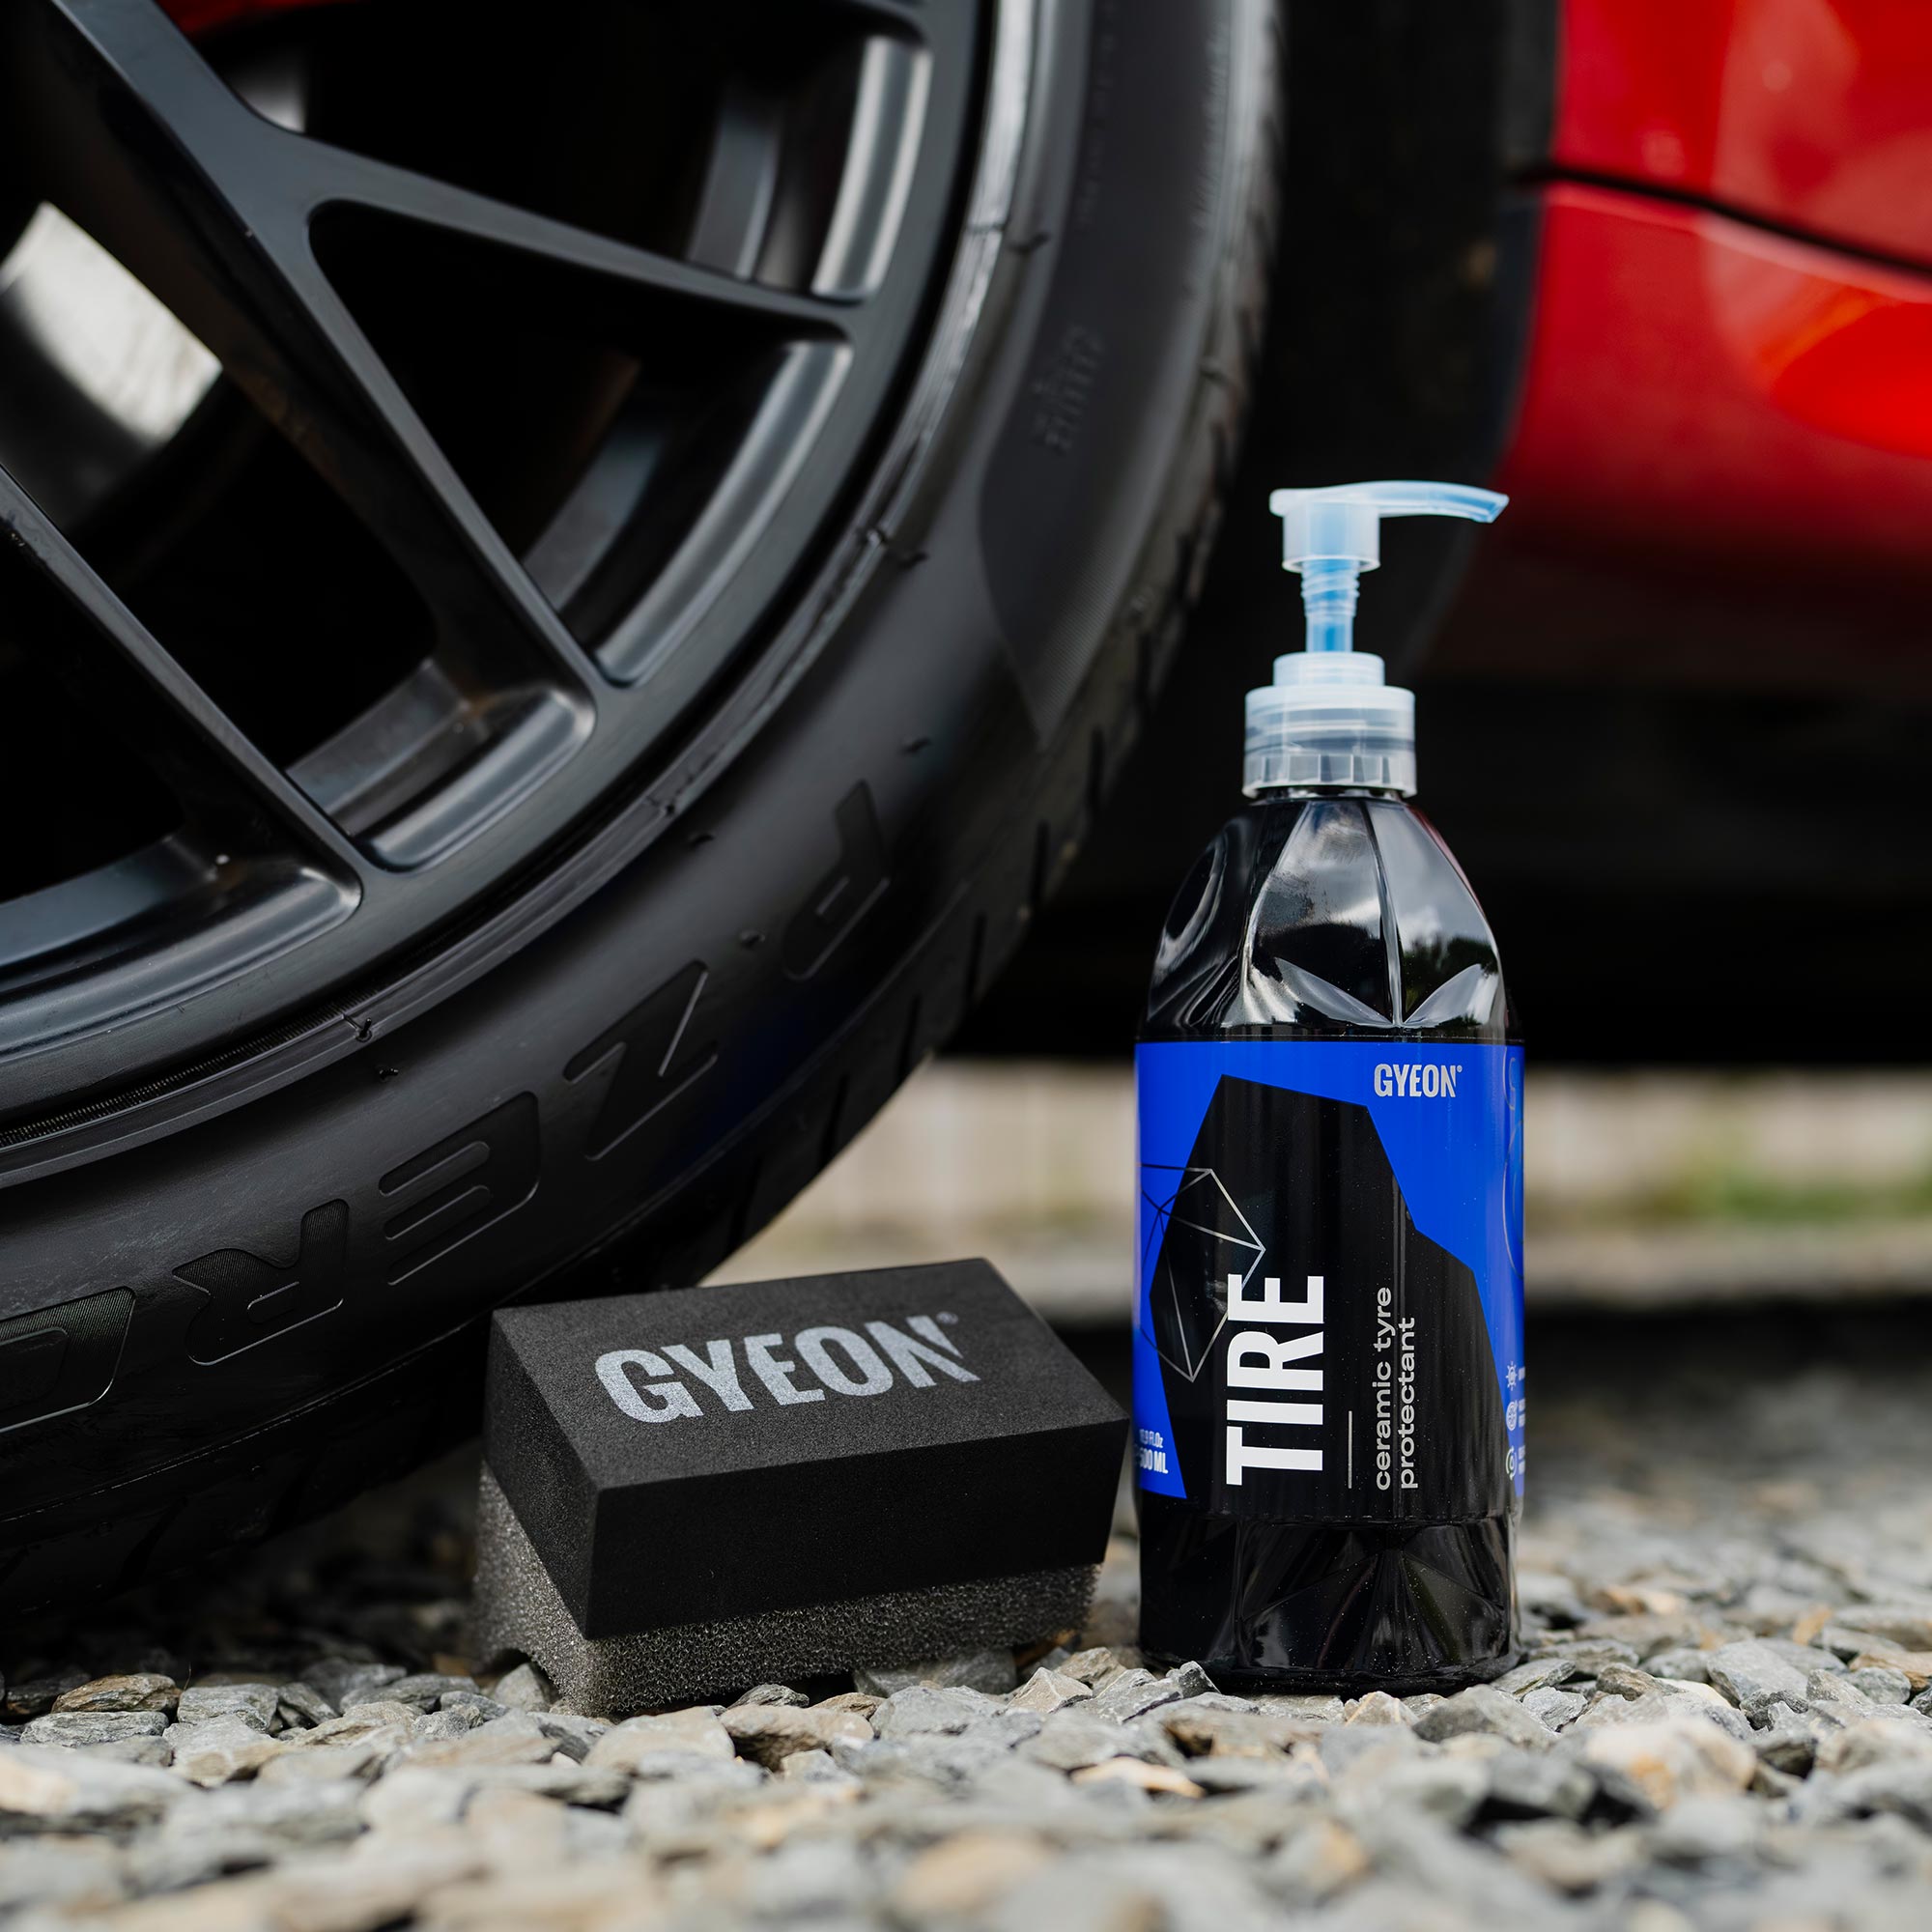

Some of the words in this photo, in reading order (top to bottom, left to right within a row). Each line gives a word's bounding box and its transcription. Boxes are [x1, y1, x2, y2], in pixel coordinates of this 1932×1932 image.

[1226, 1273, 1324, 1486] TIRE
[1373, 1287, 1396, 1352] tyre
[1153, 1450, 1169, 1474] ML
[1372, 1361, 1392, 1491] ceramic
[1398, 1317, 1418, 1490] protectant
